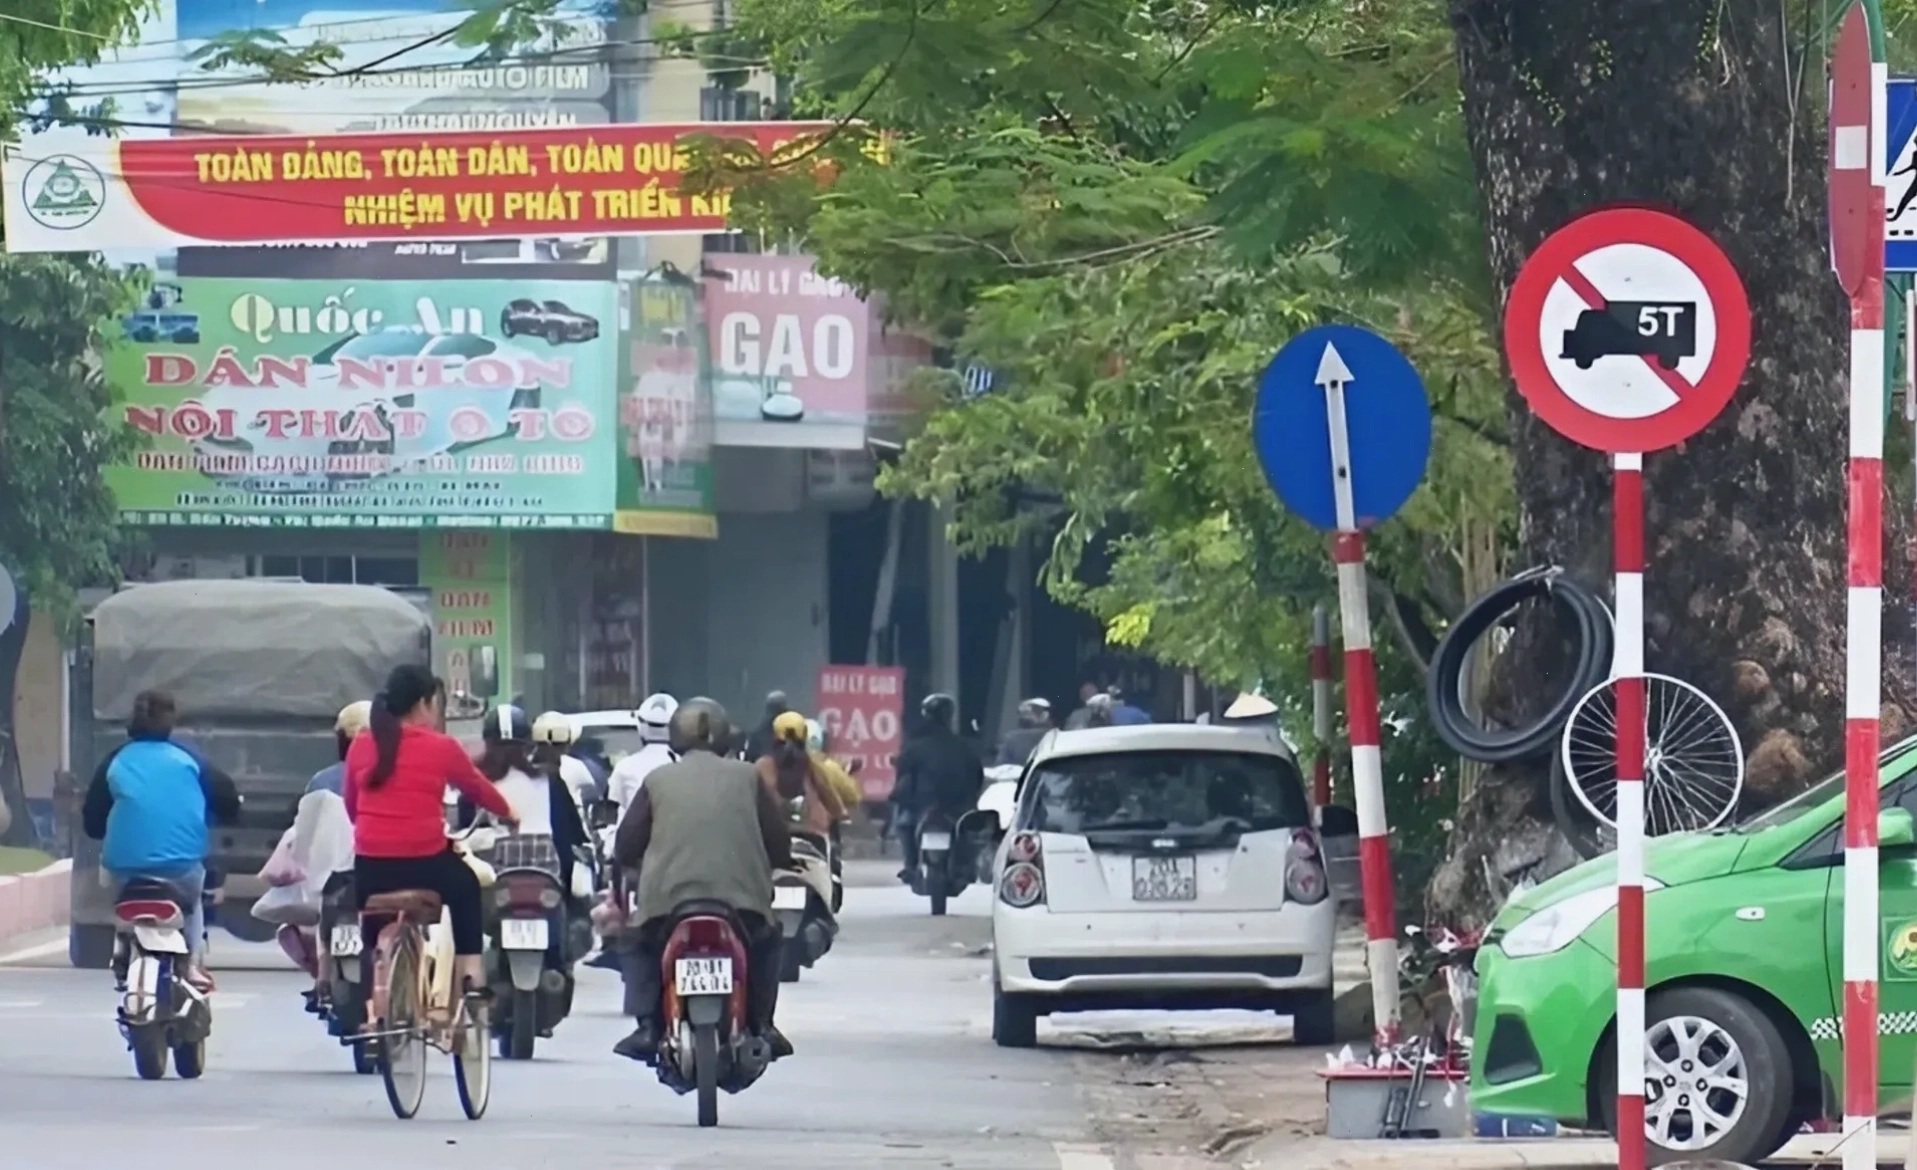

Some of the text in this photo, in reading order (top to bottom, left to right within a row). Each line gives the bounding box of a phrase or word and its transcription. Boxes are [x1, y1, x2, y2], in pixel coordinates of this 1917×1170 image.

[194, 148, 272, 183] TOÀN
[282, 140, 372, 180] ĐẢNG,
[381, 141, 458, 177] TOÀN
[468, 140, 537, 176] DÂN,
[546, 137, 624, 173] TOÀN
[344, 188, 445, 230] NHIỆM
[455, 193, 494, 228] VỤ
[505, 184, 583, 221] PHÁT
[592, 177, 680, 219] TRIỂN
[231, 287, 383, 343] Quốc
[1638, 306, 1684, 337] 5T
[144, 345, 309, 389] DÁN
[124, 399, 236, 443] NỘI
[819, 707, 898, 748] GẠO
